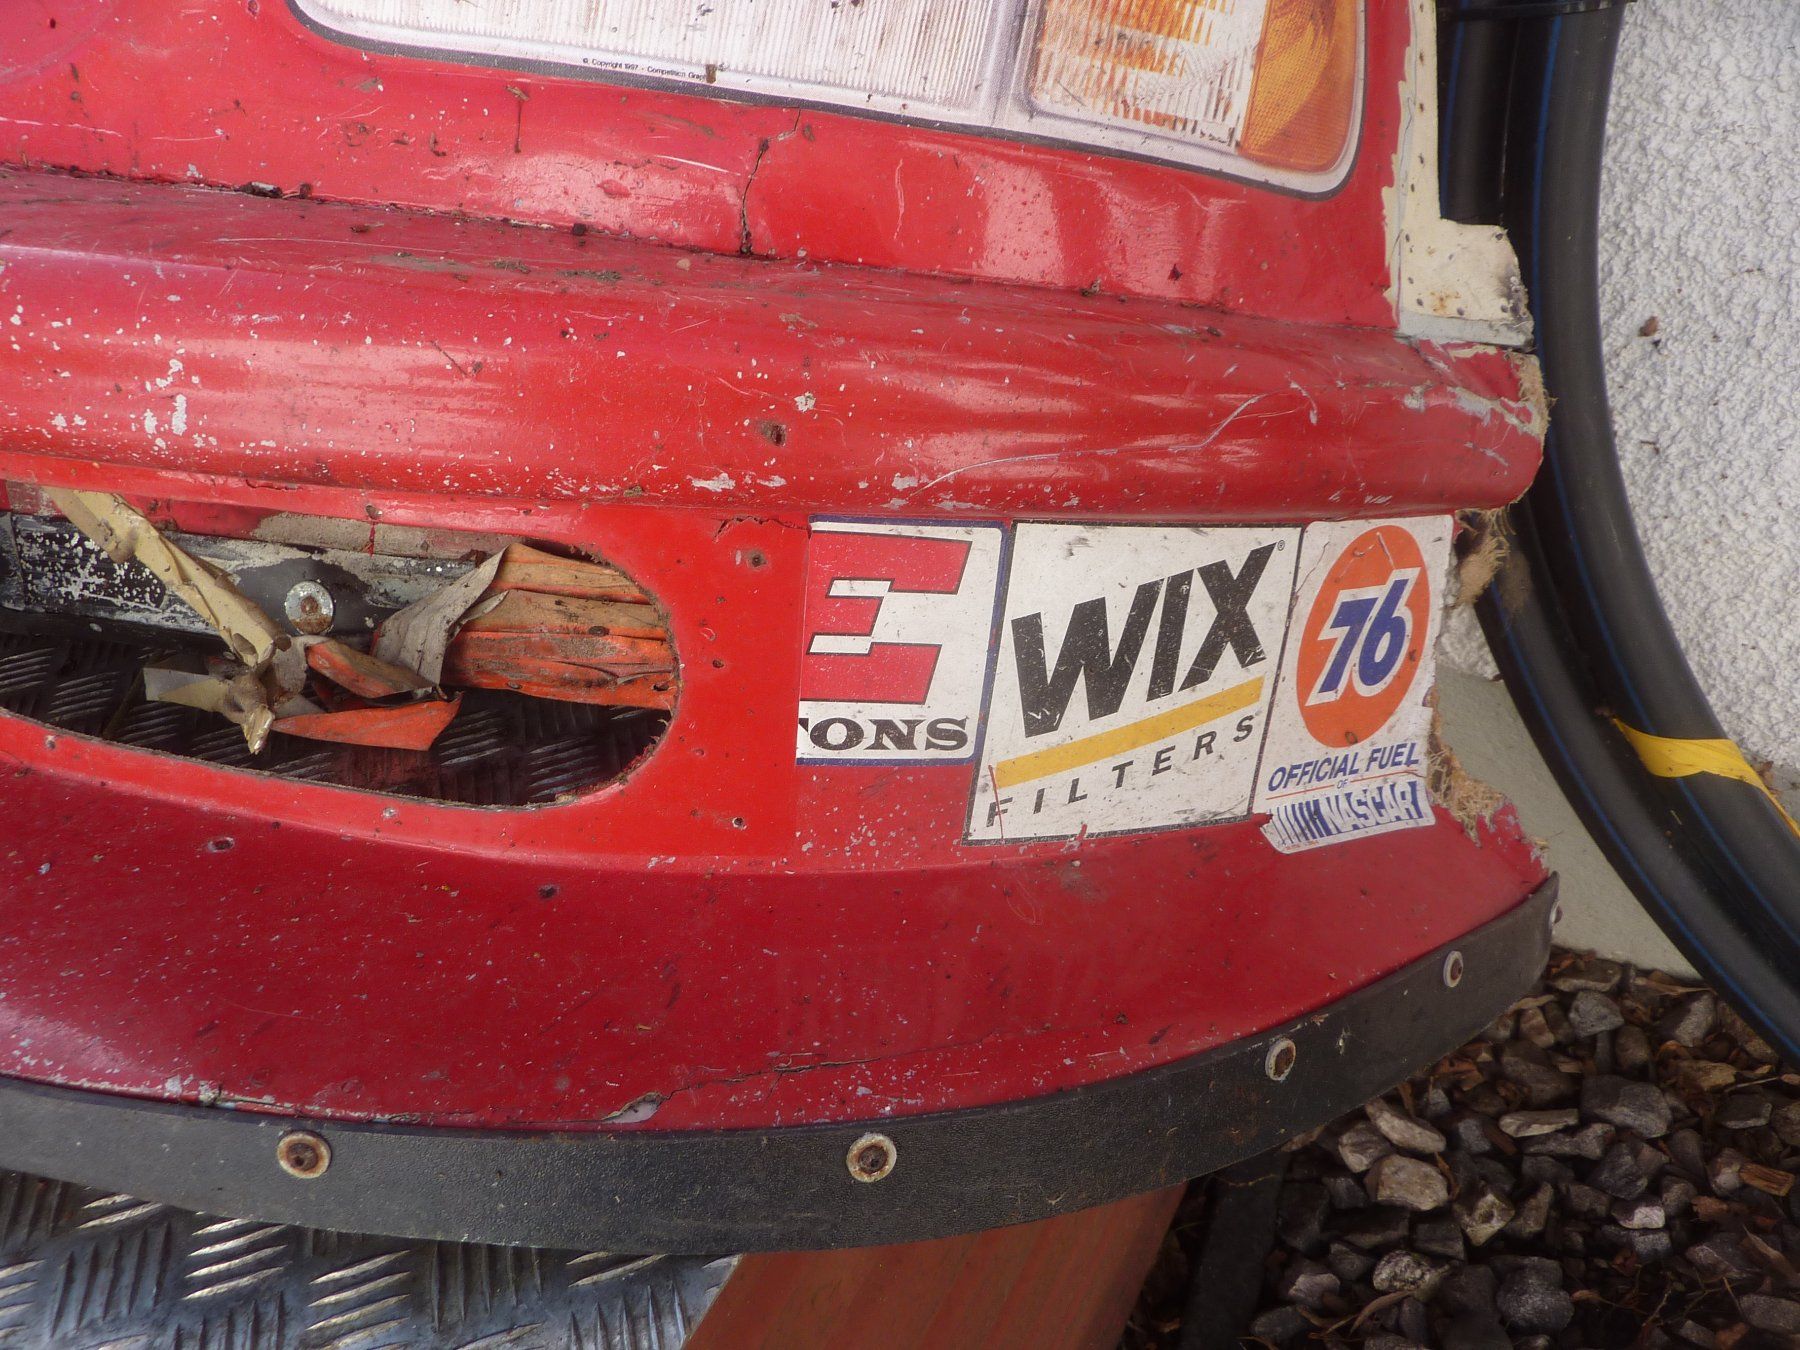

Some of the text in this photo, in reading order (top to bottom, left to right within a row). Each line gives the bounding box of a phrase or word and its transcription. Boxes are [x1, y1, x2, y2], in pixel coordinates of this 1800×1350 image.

[592, 58, 623, 70] Copyright
[647, 66, 686, 78] Competition
[1313, 573, 1415, 700] 76
[798, 715, 969, 751] ONS
[986, 713, 1256, 828] FILTERS
[1268, 743, 1420, 792] OFFICIAL FUEL
[1336, 779, 1349, 789] OF
[1319, 781, 1419, 836] NASCAR
